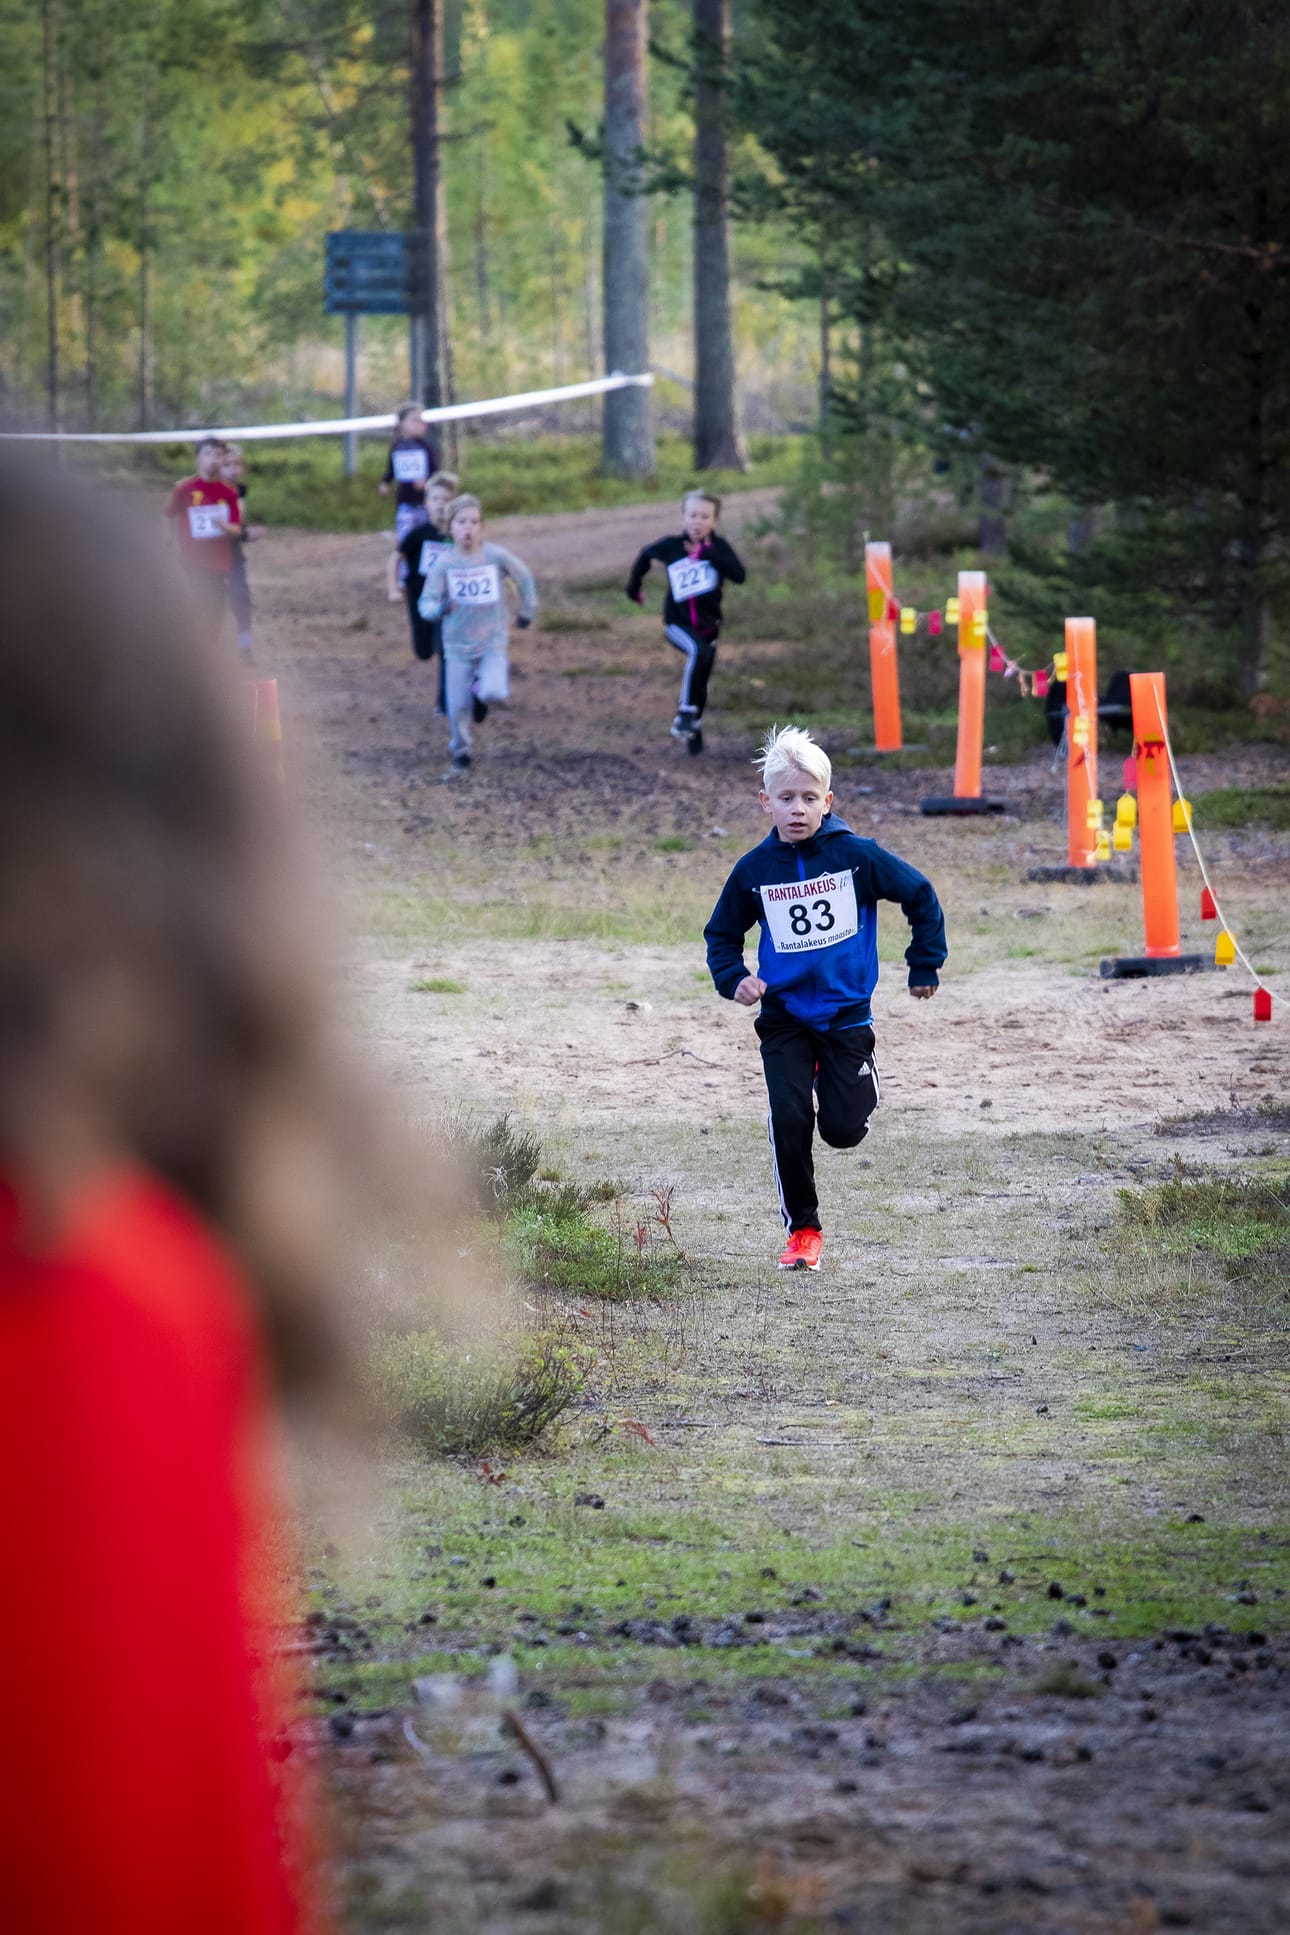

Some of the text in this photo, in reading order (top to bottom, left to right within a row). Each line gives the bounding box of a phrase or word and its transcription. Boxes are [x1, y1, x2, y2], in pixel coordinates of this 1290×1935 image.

[455, 577, 491, 597] 202
[767, 877, 837, 902] RANTALAKEUS
[788, 899, 836, 936] 83
[780, 938, 827, 951] Rantalakeus
